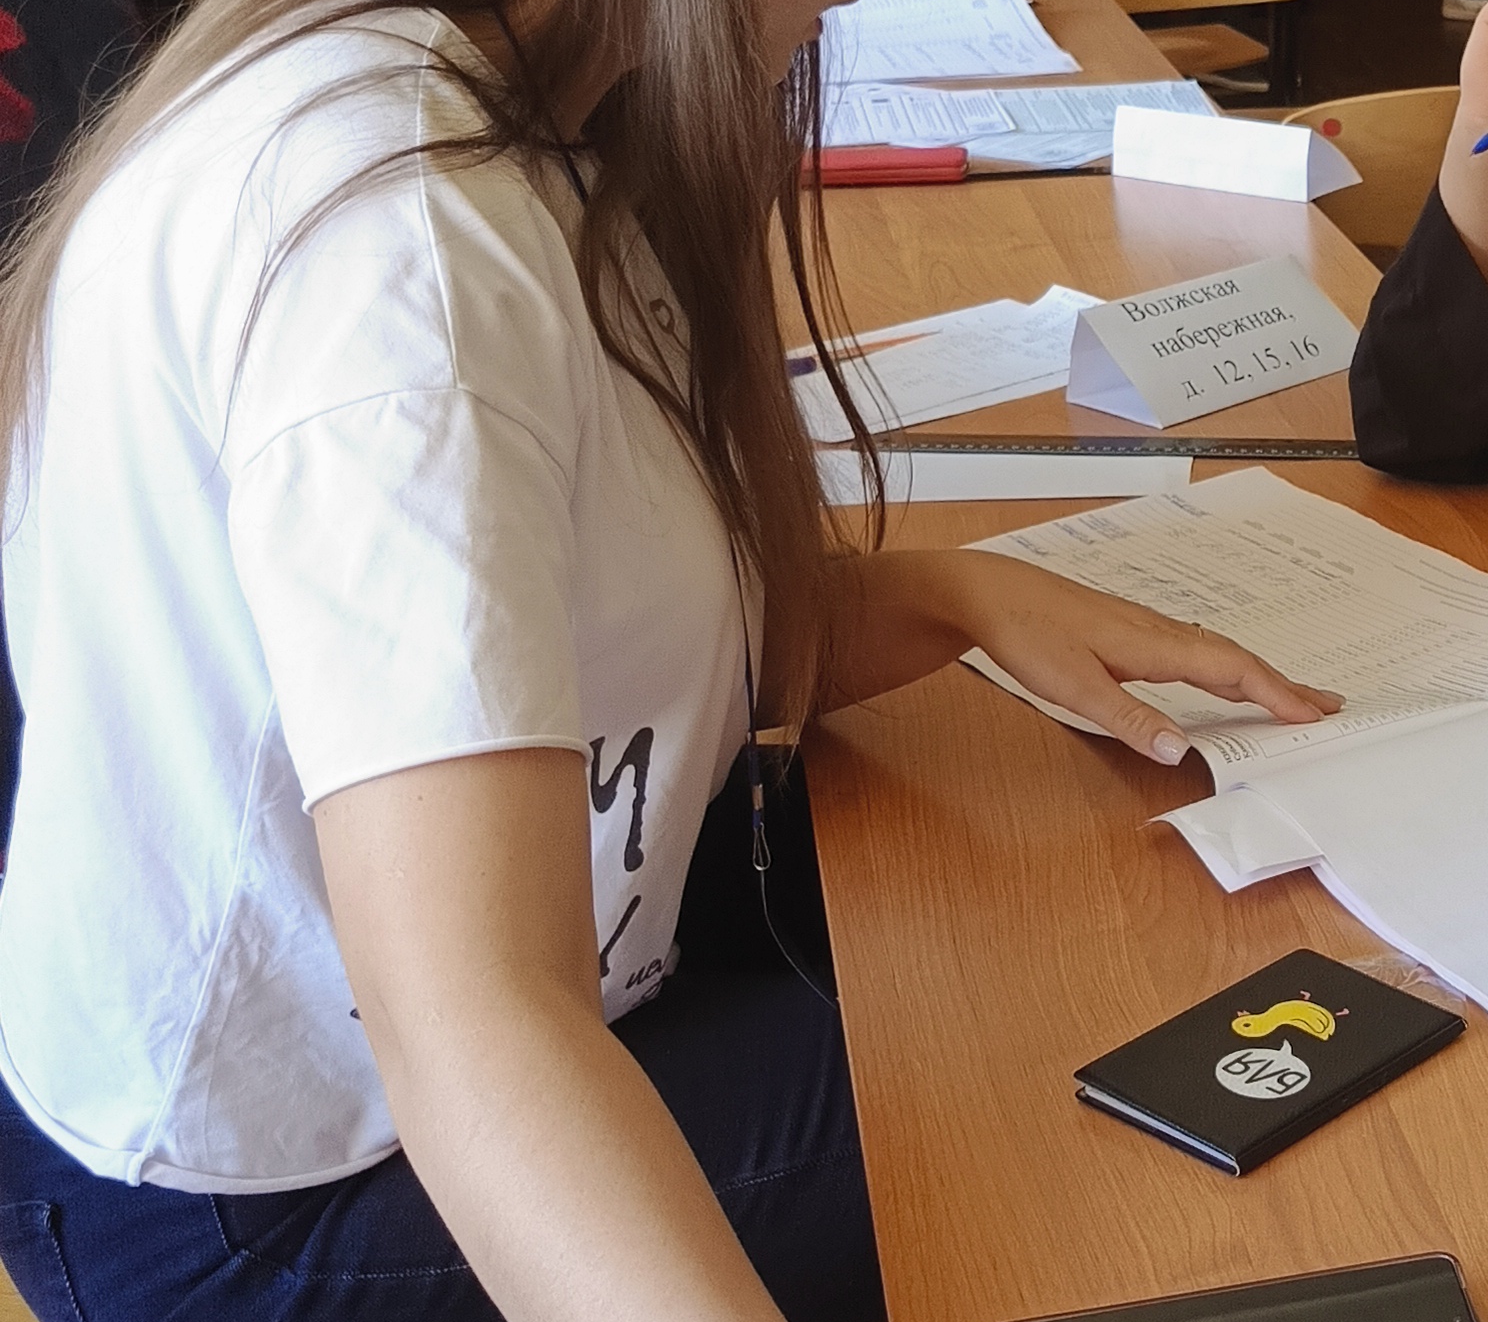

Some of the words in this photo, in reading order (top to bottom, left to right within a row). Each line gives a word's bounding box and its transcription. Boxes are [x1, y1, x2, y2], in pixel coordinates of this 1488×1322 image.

[1121, 278, 1241, 323] Волжская
[1151, 304, 1298, 359] набережная,
[1180, 379, 1205, 400] д.
[1213, 359, 1252, 386] 12,
[1253, 347, 1290, 374] 15,
[1291, 334, 1321, 361] 16
[1222, 1052, 1308, 1095] БЛЯ
